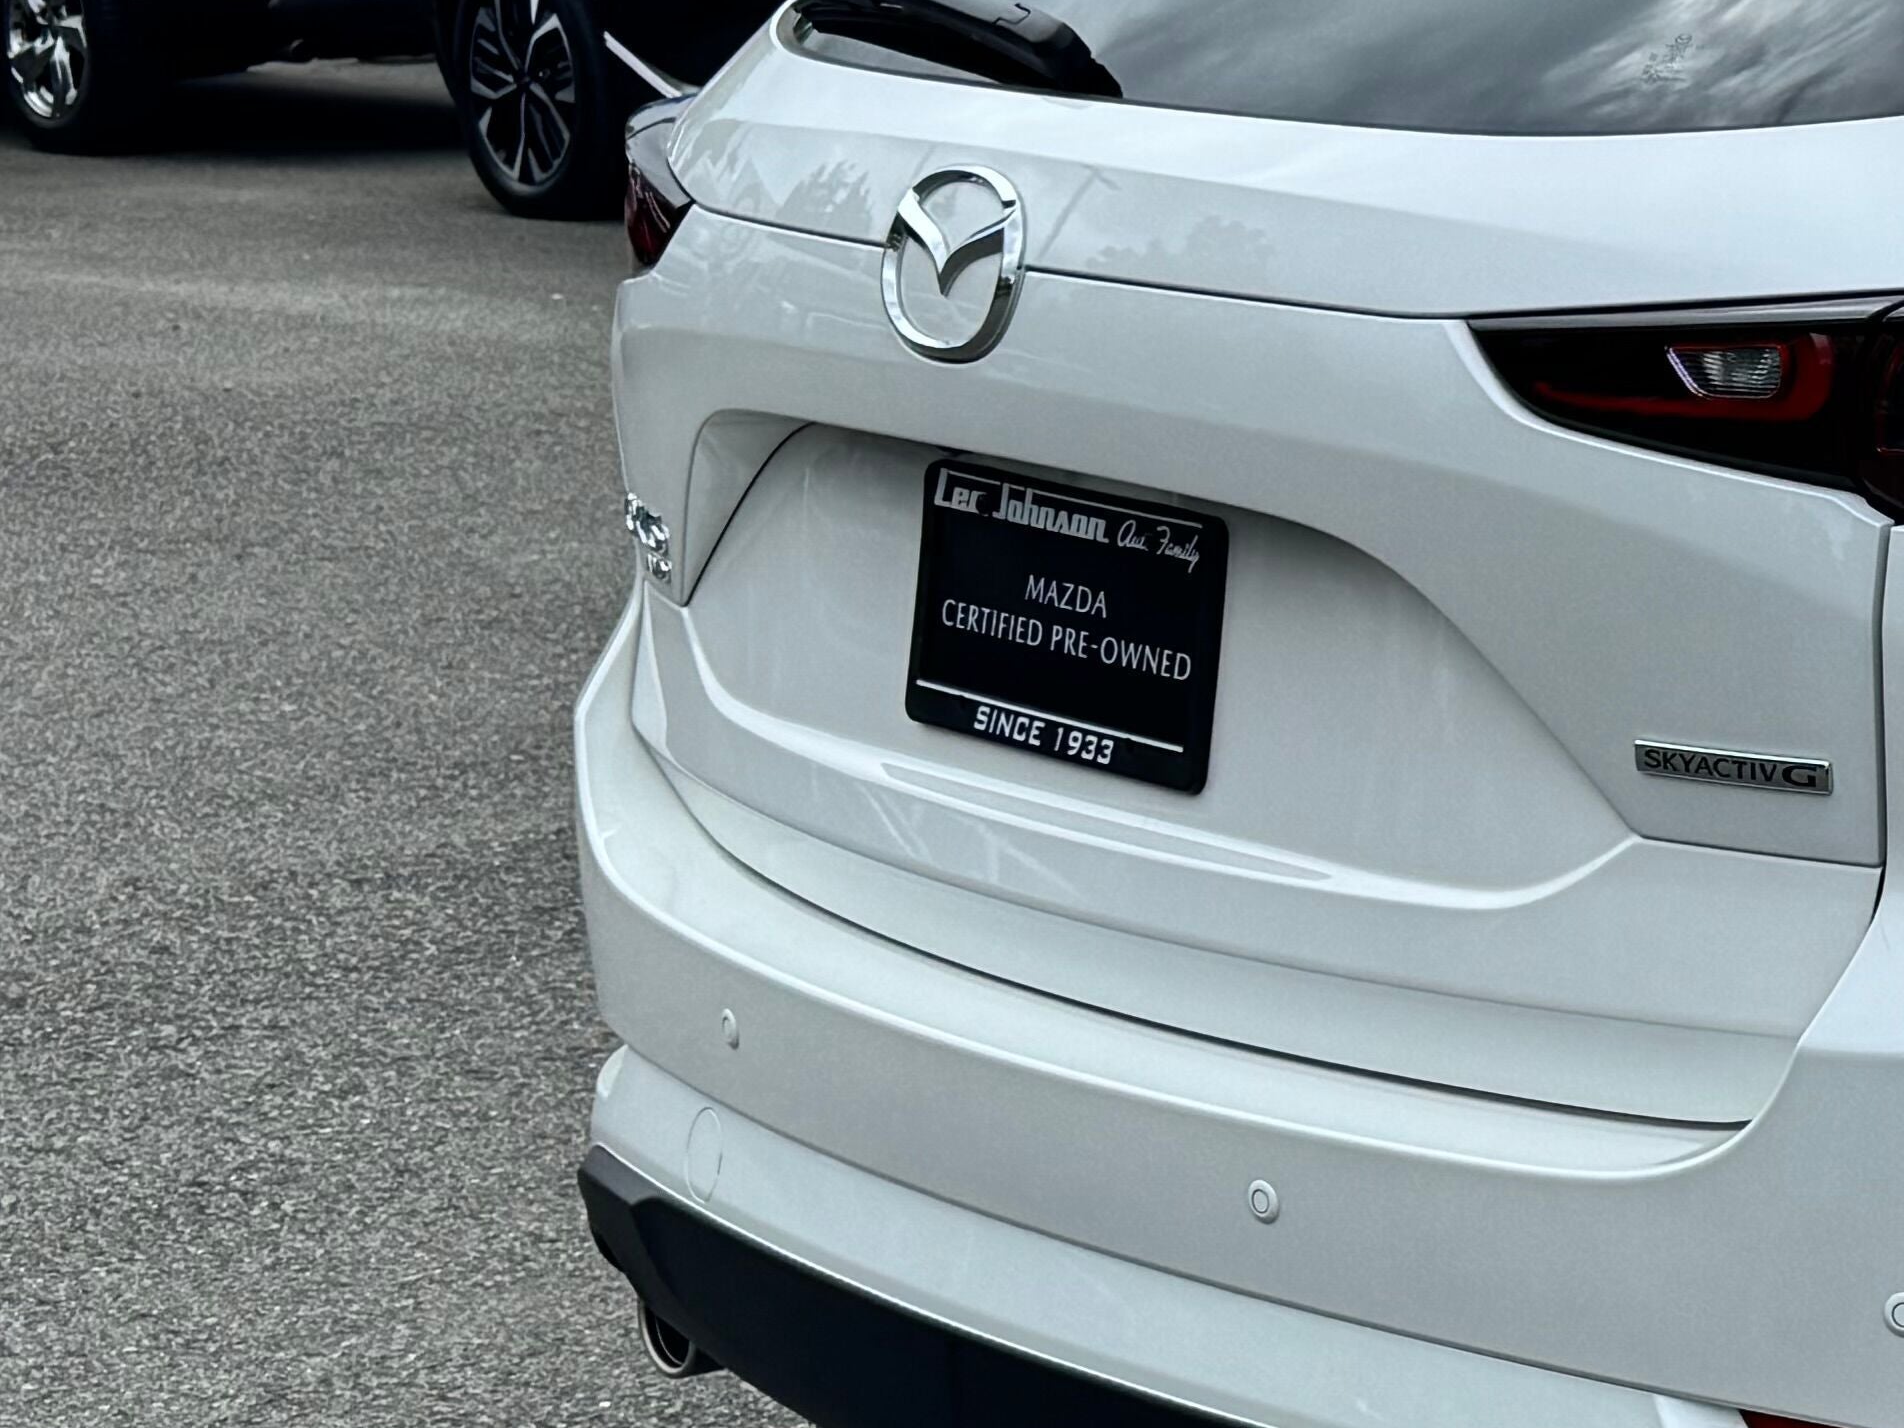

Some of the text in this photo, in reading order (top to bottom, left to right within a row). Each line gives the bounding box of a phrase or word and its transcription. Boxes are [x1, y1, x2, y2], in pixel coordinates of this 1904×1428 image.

[991, 482, 1110, 544] Johnson
[1024, 574, 1107, 619] MAZDA
[941, 598, 1192, 681] CERTIFIED PRE-OWNED
[973, 705, 1115, 766] SINCE 1933
[1643, 748, 1818, 789] SKYACTIV G
